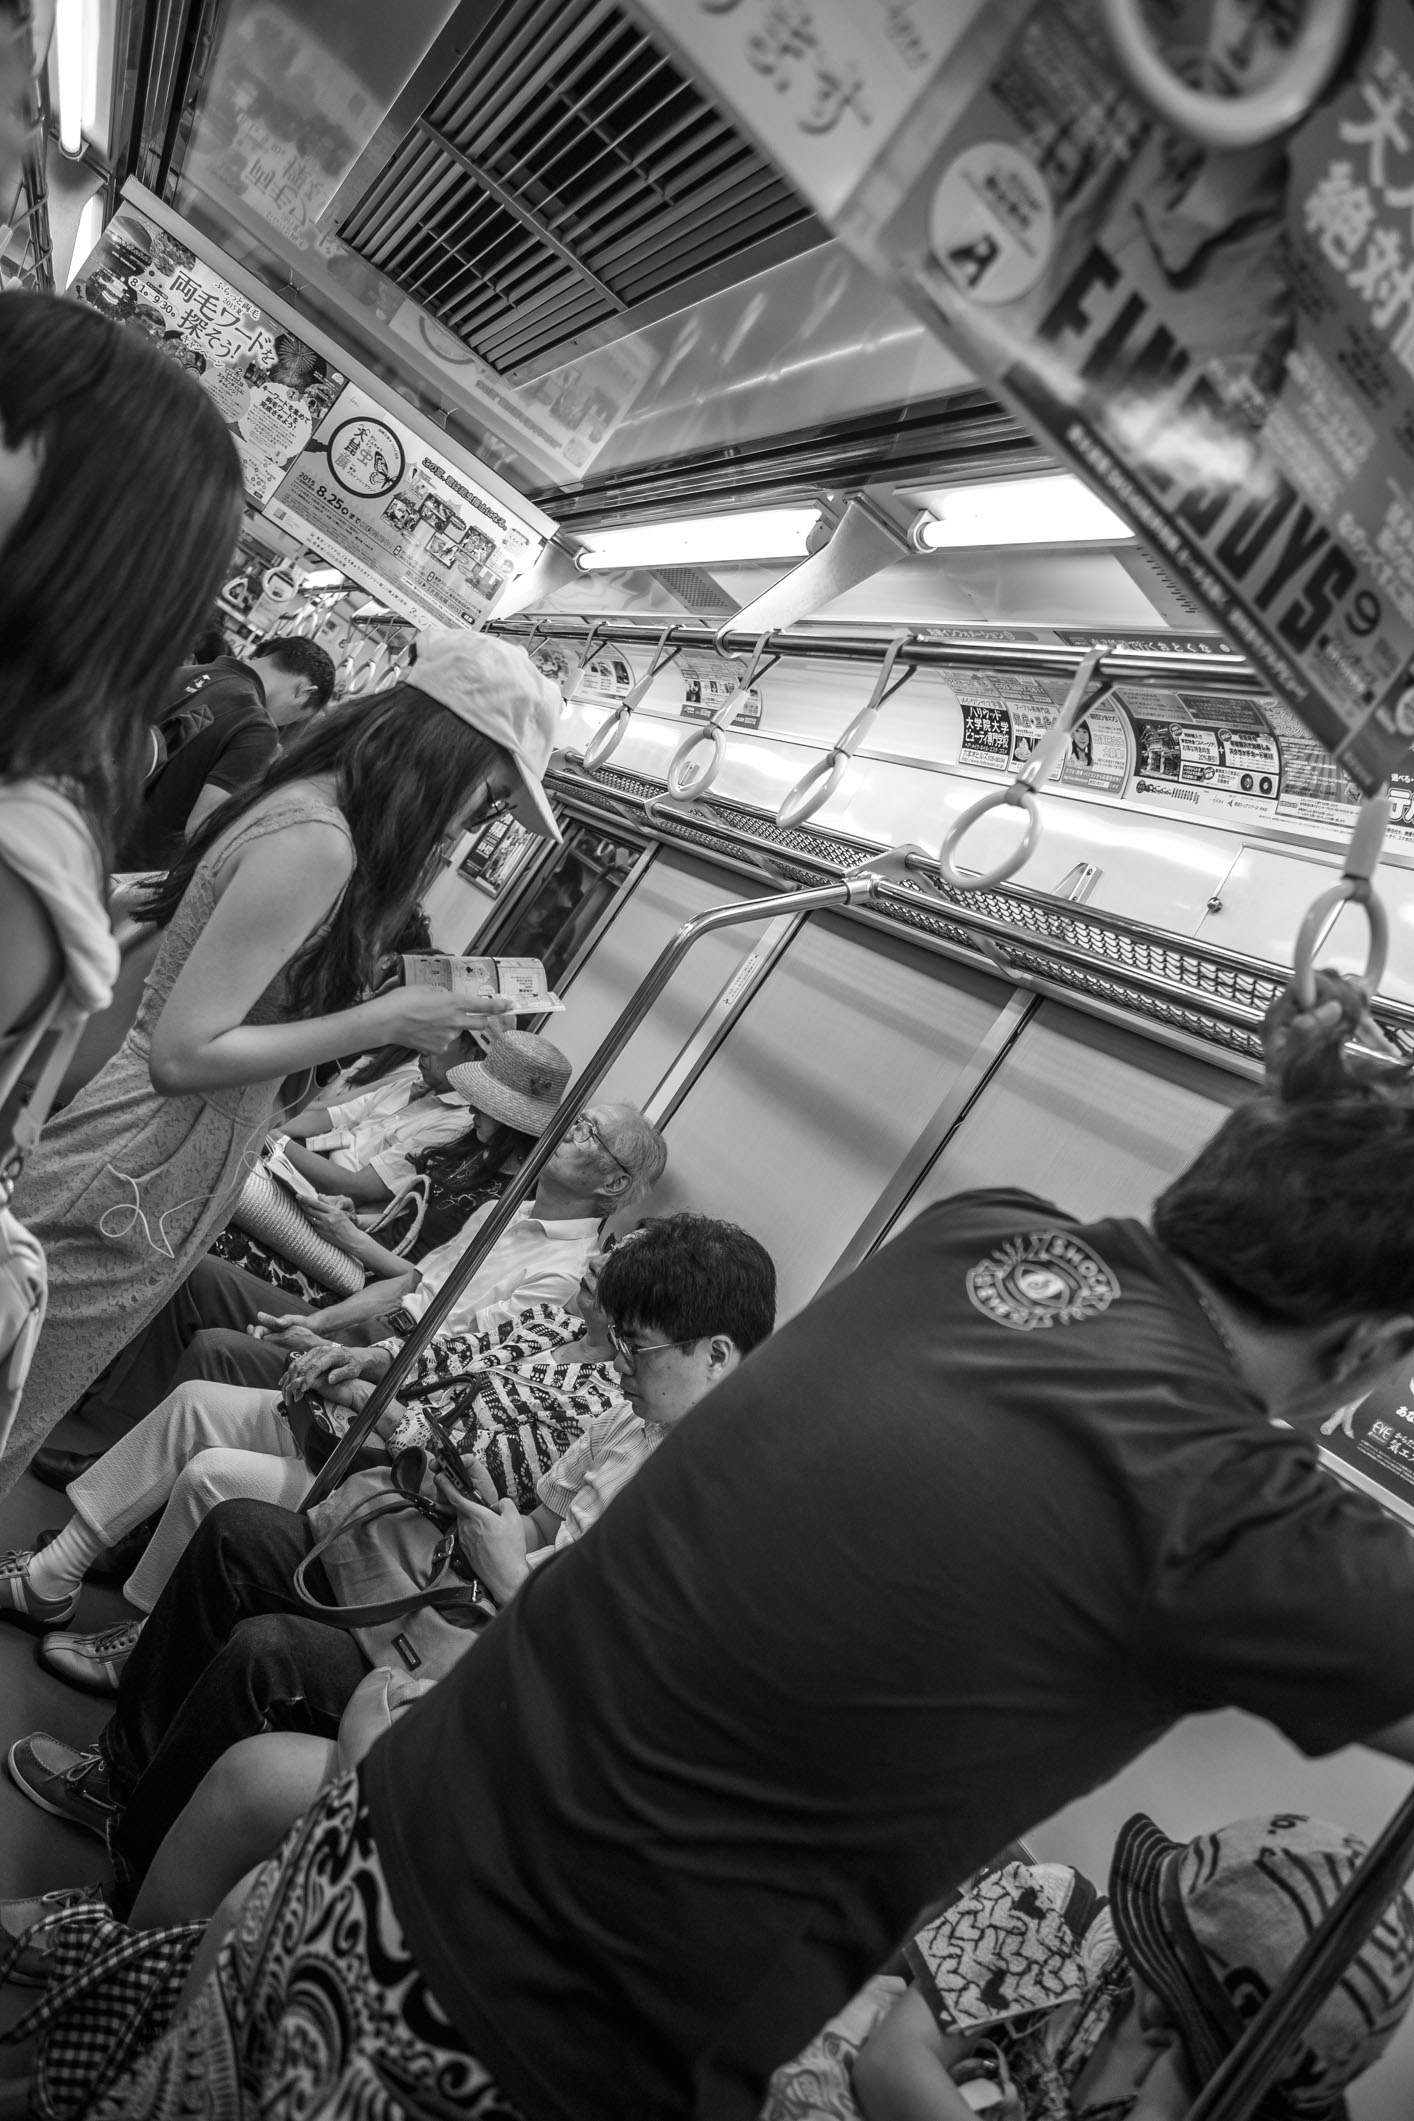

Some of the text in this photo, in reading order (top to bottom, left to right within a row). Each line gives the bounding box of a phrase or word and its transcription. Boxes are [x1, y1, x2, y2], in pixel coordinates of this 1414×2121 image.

[167, 268, 282, 368] 両毛ワードを
[175, 304, 242, 366] 探そう!
[181, 334, 223, 367] キャンペーン
[258, 399, 297, 432] 完成させよう!
[260, 382, 310, 425] キーワードを集めて
[265, 395, 299, 425] 両毛ワードを
[297, 470, 317, 487] 2015
[417, 455, 512, 532] この夏、君は昆虫博士になる。
[965, 716, 1009, 734] 大学院大学
[969, 706, 1002, 721] ハリウッド
[965, 728, 1009, 749] ビューティ専門学校
